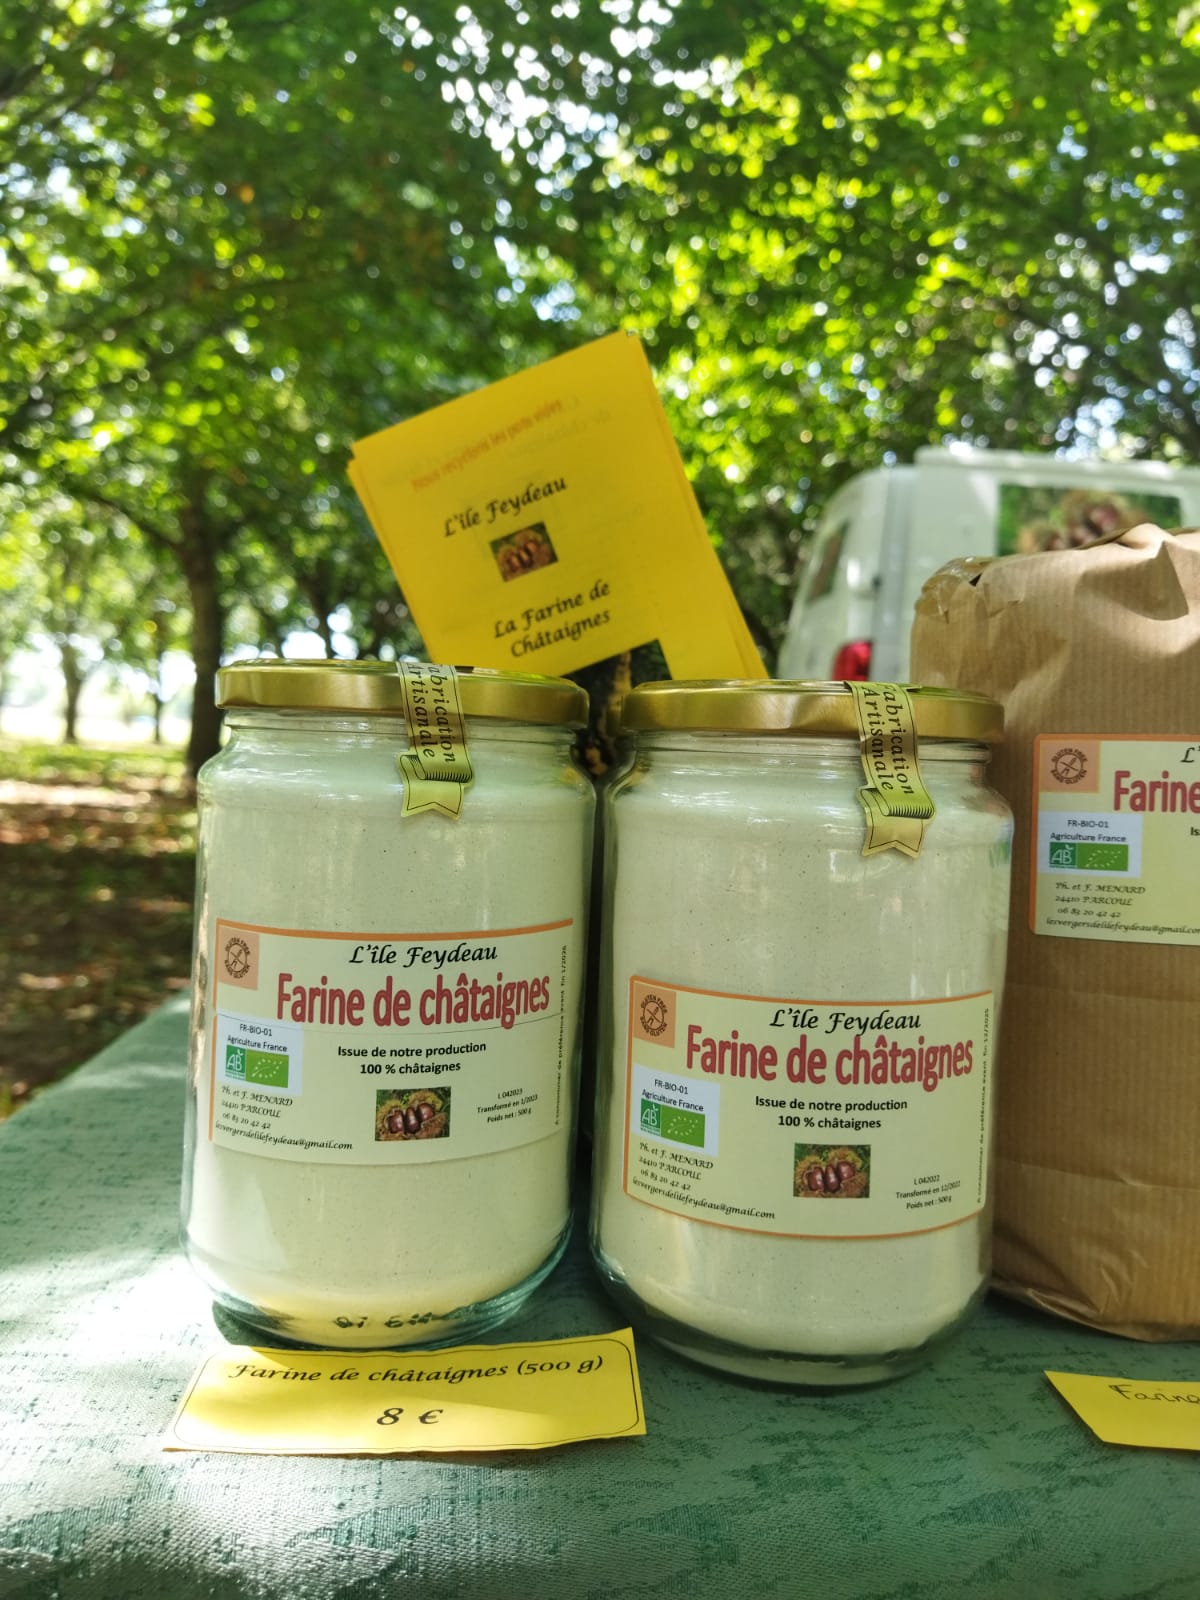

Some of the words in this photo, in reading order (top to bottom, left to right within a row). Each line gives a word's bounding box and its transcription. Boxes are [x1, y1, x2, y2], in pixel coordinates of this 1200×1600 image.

[486, 478, 567, 524] Feydeau
[495, 620, 517, 639] La
[522, 594, 584, 631] Farine
[589, 578, 610, 601] de
[510, 610, 610, 657] Châtaignes
[427, 662, 456, 763] abrication
[861, 687, 894, 791] Artisanale
[1113, 770, 1200, 814] Farine
[1067, 820, 1109, 828] FR-BIO-01
[1050, 832, 1096, 841] Agriculture
[1098, 834, 1127, 842] France
[1051, 848, 1072, 864] AB
[1095, 884, 1146, 894] MENARD
[1082, 896, 1133, 906] PARCOUL
[349, 944, 397, 964] L'île
[403, 943, 498, 969] Feydeau
[277, 973, 365, 1026] Farine
[373, 975, 411, 1026] de
[419, 972, 550, 1030] châtaignes
[239, 1023, 273, 1037] FR-BIO-01
[769, 1008, 818, 1029] L'île
[824, 1009, 921, 1036] Feydeau
[227, 1035, 262, 1049] Agriculture
[263, 1042, 288, 1052] France
[338, 1046, 368, 1057] Issue
[371, 1047, 386, 1057] de
[390, 1047, 423, 1057] notre
[426, 1042, 487, 1058] production
[226, 1054, 243, 1072] AB
[686, 1024, 778, 1081] Farine
[786, 1034, 827, 1084] de
[835, 1034, 973, 1092] châtaignes
[360, 1064, 382, 1074] 100
[385, 1064, 396, 1074] %
[398, 1061, 461, 1075] châtaignes
[654, 1079, 689, 1095] FR-BIO-01
[250, 1093, 293, 1107] MENARD
[477, 1102, 511, 1113] Transformé
[641, 1088, 677, 1106] Agriculture
[678, 1099, 704, 1112] France
[755, 1096, 786, 1108] Issue
[789, 1099, 805, 1110] de
[808, 1100, 842, 1111] notre
[845, 1100, 908, 1113] production
[240, 1104, 281, 1118] PARCOUL
[487, 1114, 503, 1123] Poids
[505, 1112, 514, 1120] net
[642, 1108, 658, 1126] AB
[250, 1119, 259, 1128] 42
[778, 1115, 800, 1127] 100
[803, 1117, 815, 1128] %
[817, 1117, 881, 1131] châtaignes
[651, 1147, 658, 1155] et
[670, 1153, 714, 1170] MENARD
[659, 1162, 701, 1180] PARCOUL
[670, 1179, 679, 1188] 42
[681, 1182, 691, 1191] 42
[896, 1188, 931, 1199] Transformé
[906, 1201, 923, 1209] Poids
[228, 1364, 321, 1382] Farine
[329, 1367, 360, 1382] de
[368, 1363, 507, 1385] châtaignes
[517, 1359, 570, 1376] (500
[576, 1355, 603, 1375] g)
[376, 1406, 403, 1426] 8
[419, 1408, 444, 1426] €
